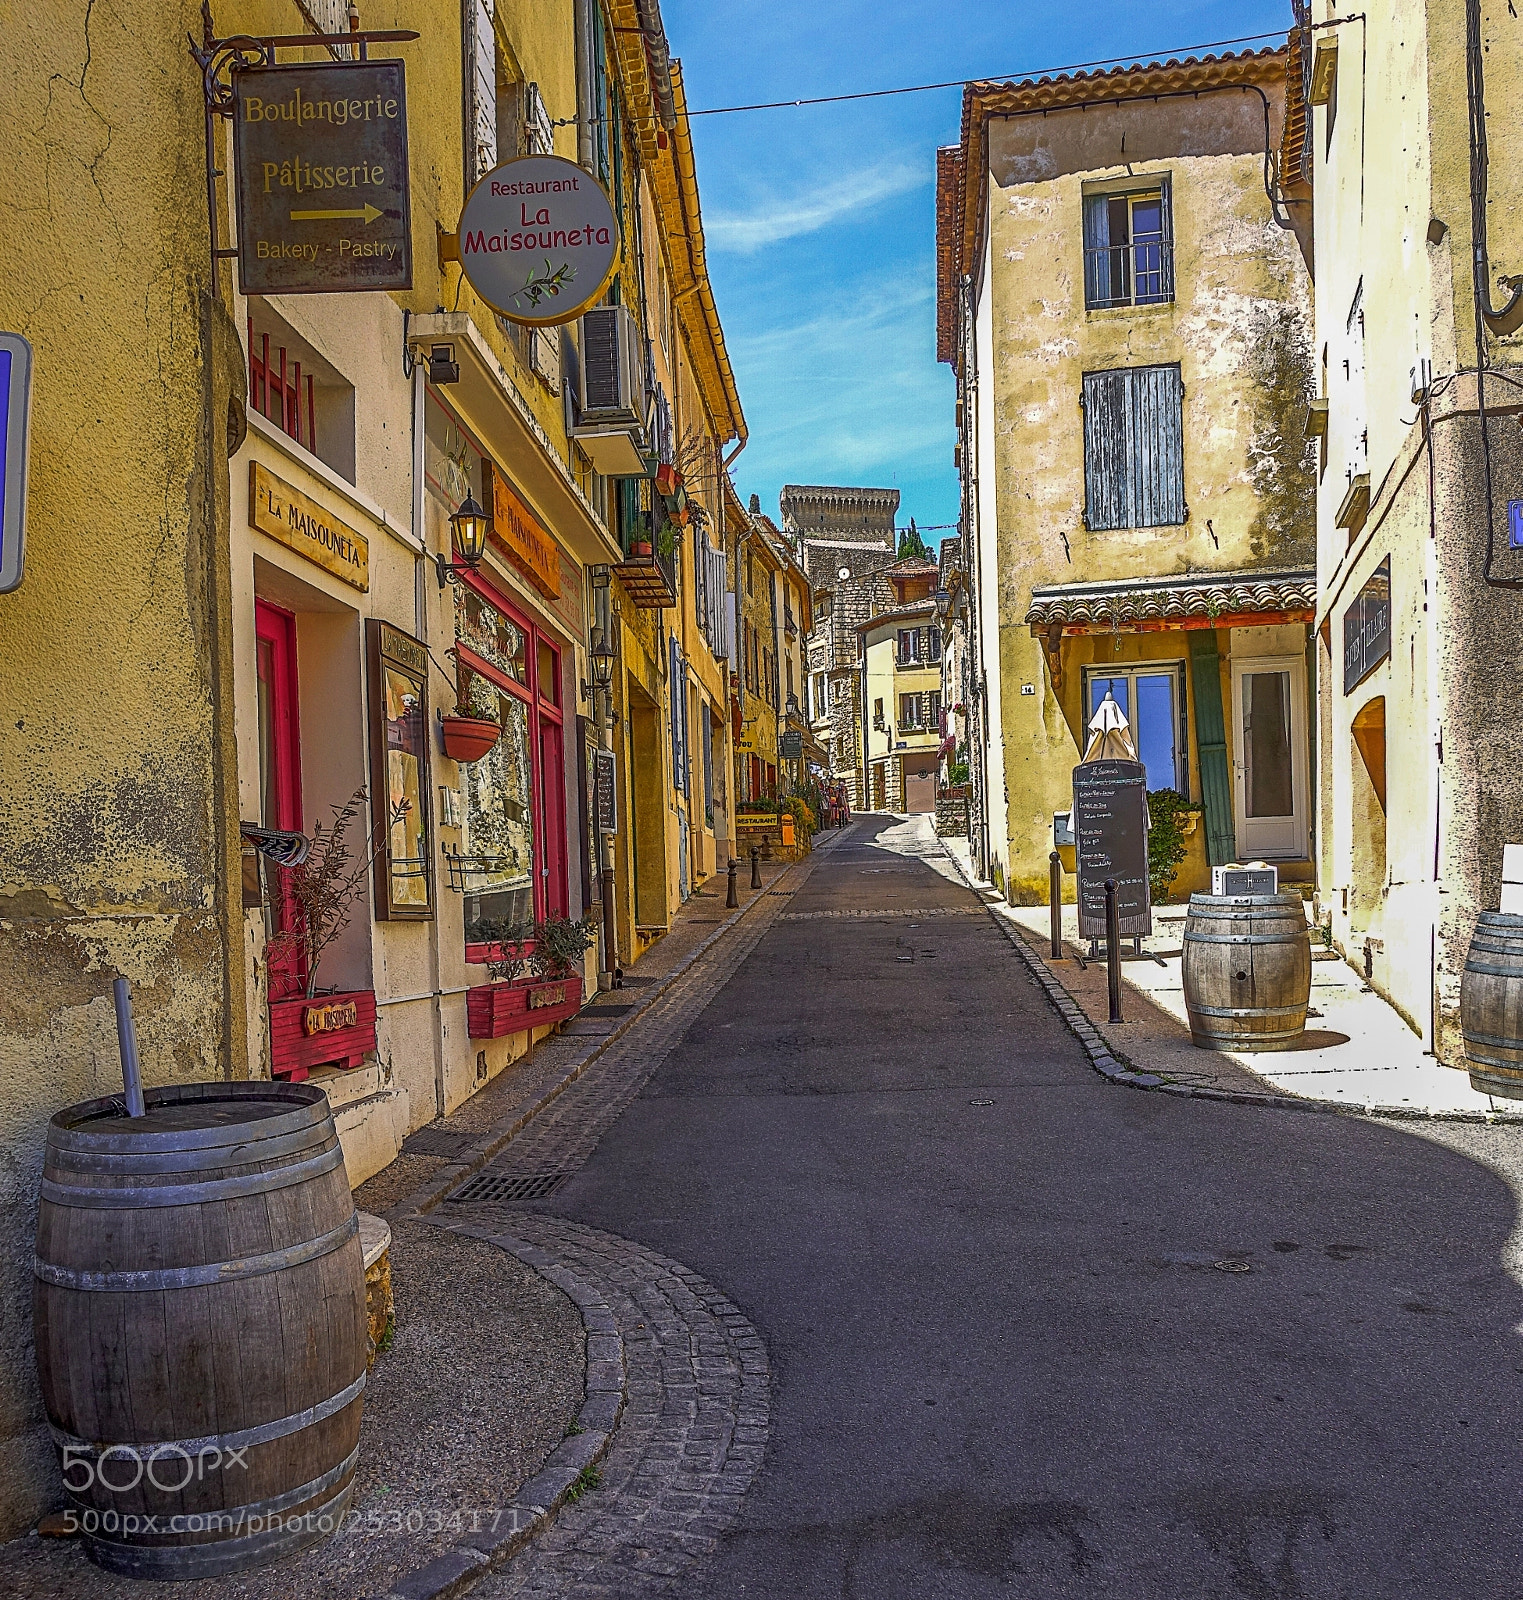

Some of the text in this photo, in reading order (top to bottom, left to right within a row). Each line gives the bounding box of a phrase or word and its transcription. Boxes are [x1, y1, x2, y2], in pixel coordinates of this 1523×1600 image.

[244, 87, 398, 127] Boulangerie
[261, 155, 385, 193] Pâtisserie
[491, 177, 580, 197] Restaurant
[520, 202, 551, 227] La
[257, 240, 320, 262] Bakery
[339, 238, 397, 261] Pastry
[464, 223, 611, 255] Maisouneta
[288, 503, 361, 569] MAISOUNETA
[737, 817, 776, 825] RESTAURANT
